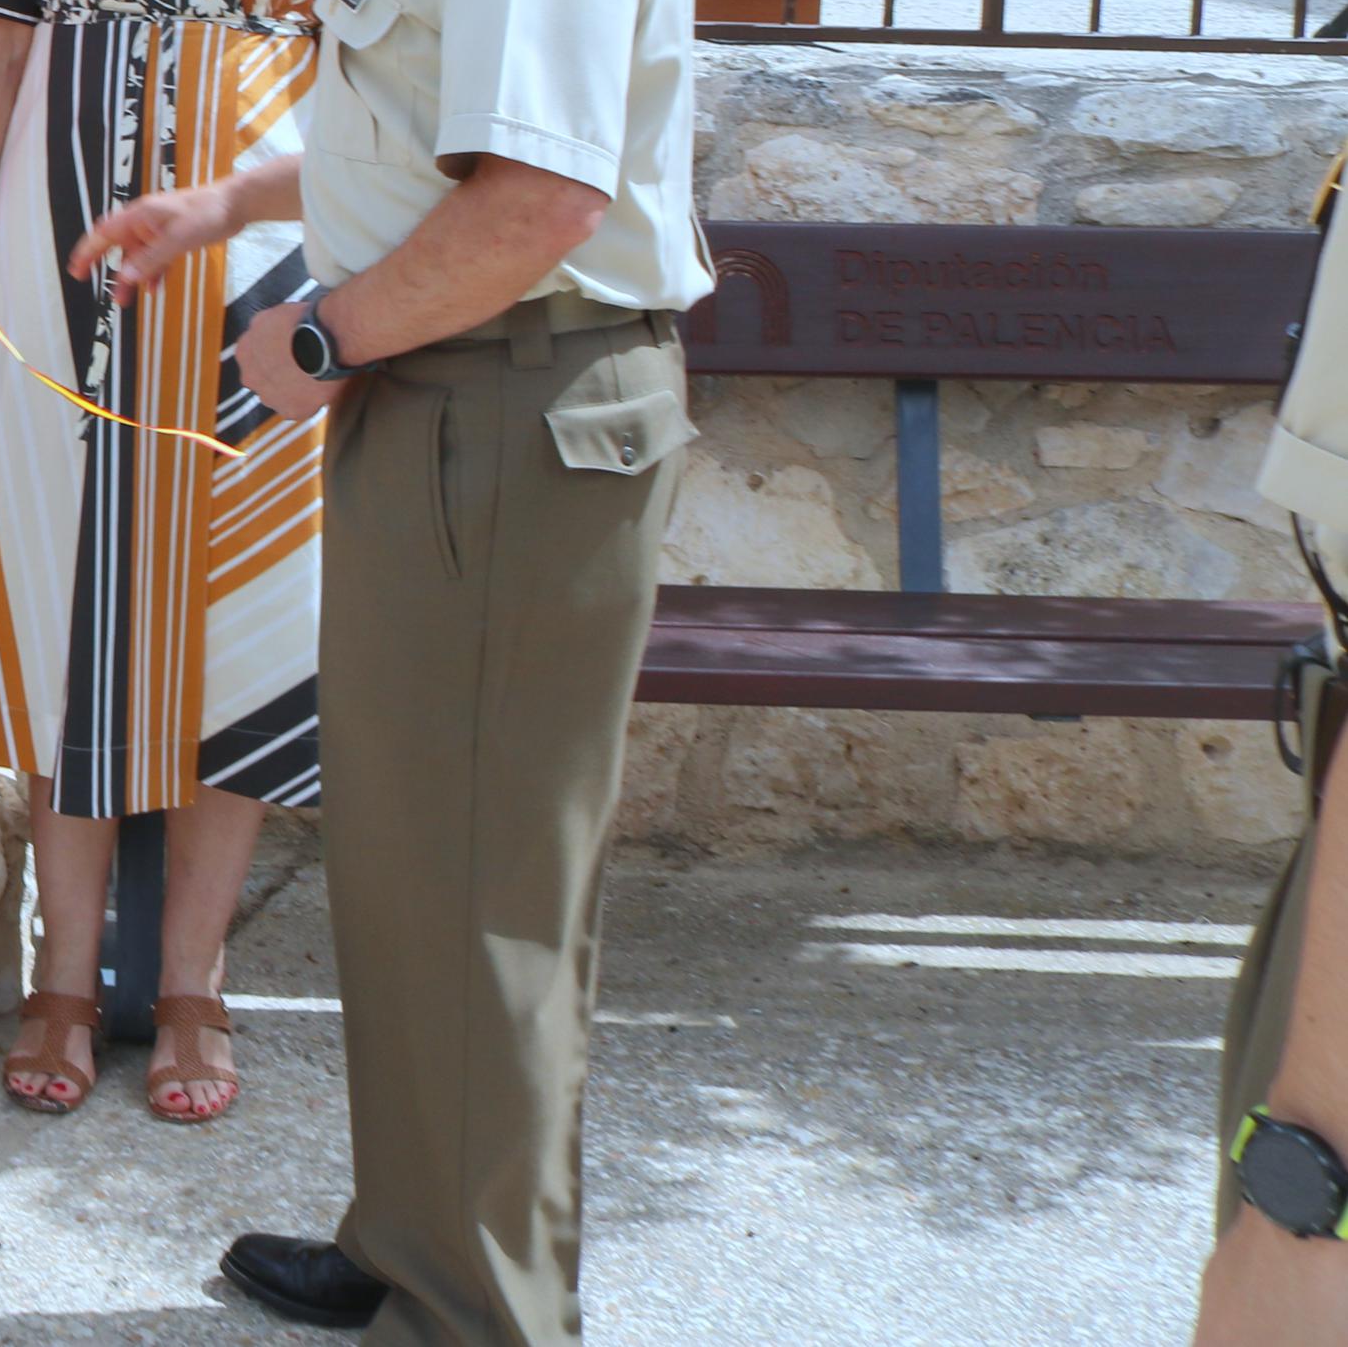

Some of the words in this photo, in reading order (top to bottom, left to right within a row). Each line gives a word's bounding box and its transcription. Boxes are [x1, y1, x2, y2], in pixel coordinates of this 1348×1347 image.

[835, 249, 1110, 297] Diputación
[836, 309, 906, 349] DE
[920, 310, 1178, 355] PALENCIA
